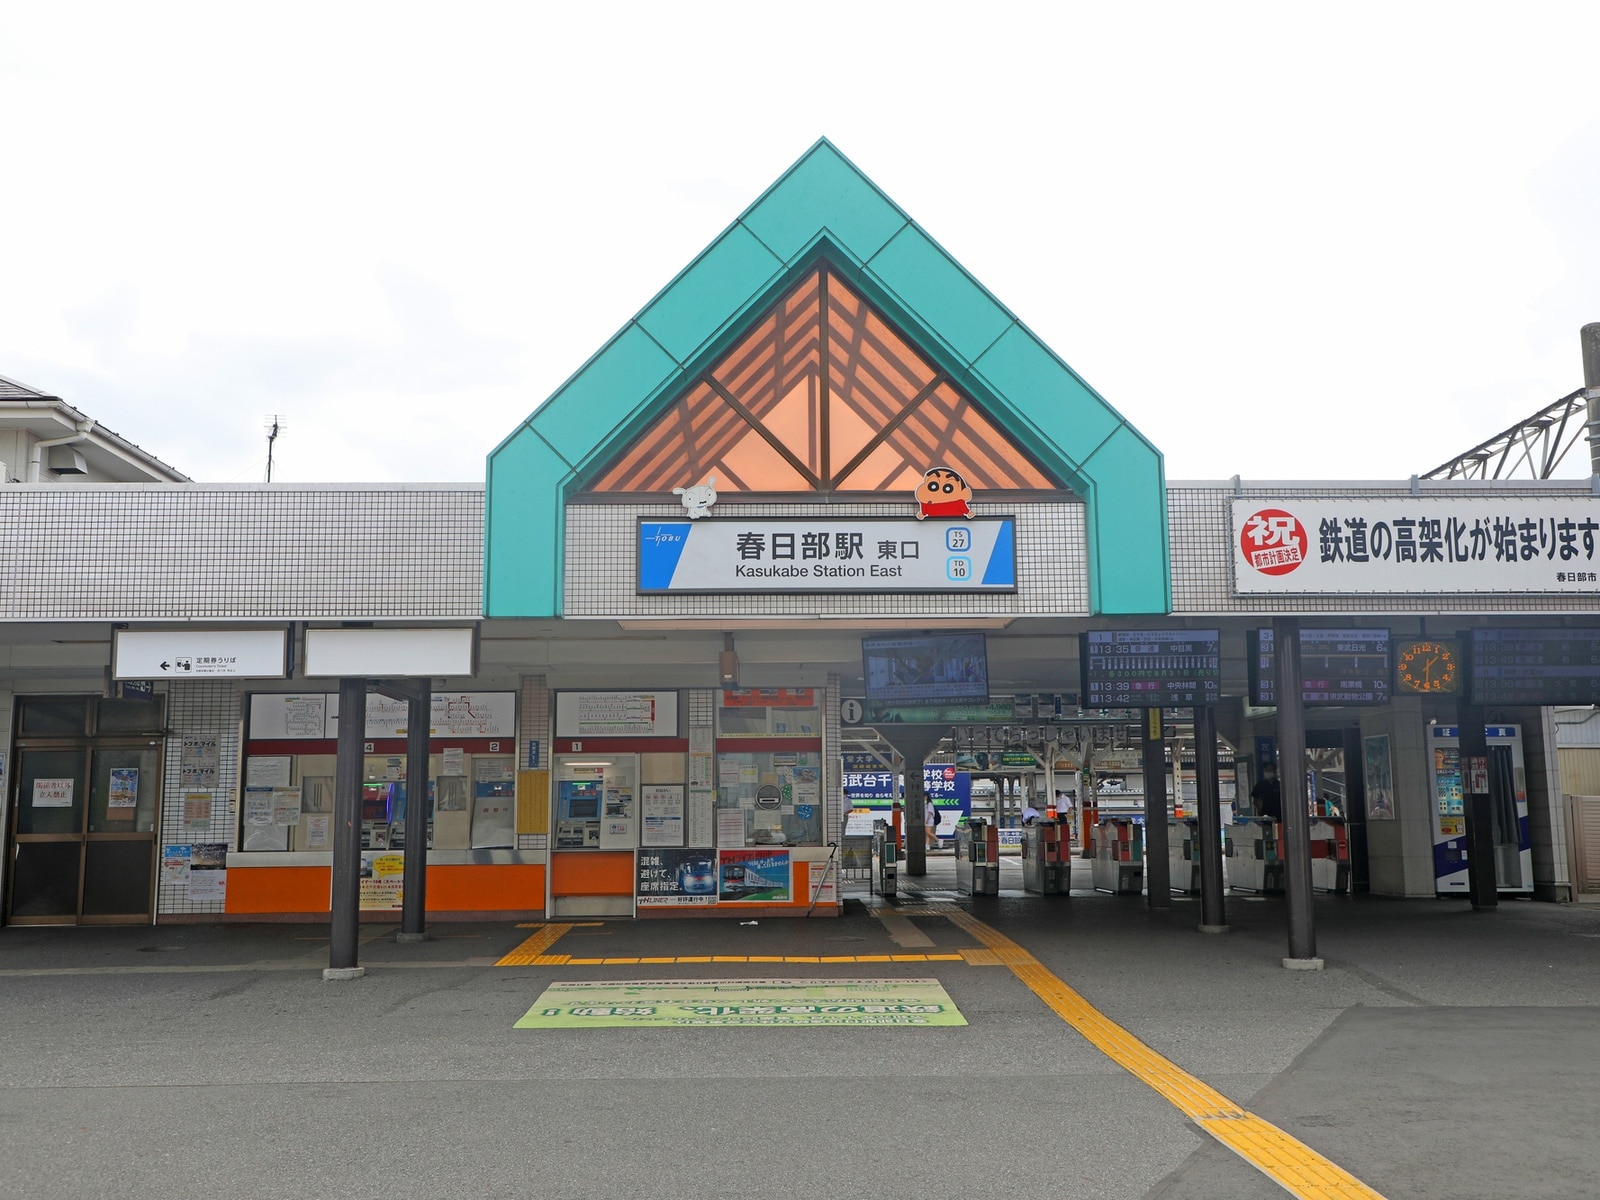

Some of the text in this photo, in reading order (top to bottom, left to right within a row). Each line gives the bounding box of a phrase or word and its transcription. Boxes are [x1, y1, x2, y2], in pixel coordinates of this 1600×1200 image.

[1247, 515, 1300, 546] 祝
[952, 538, 965, 548] 27
[1318, 516, 1600, 563] 鉄道の高架化が始まります
[736, 532, 920, 560] 春日部駅 東口
[1254, 547, 1300, 568] 都市計画決定
[736, 565, 903, 577] Kasukabe Station East
[953, 567, 966, 577] 10
[1556, 572, 1598, 583] 春日部市
[1099, 645, 1129, 654] 13:35
[1413, 646, 1421, 654] 11
[1422, 644, 1431, 652] 12
[1434, 646, 1439, 654] 1
[196, 656, 236, 664] 定期券うりば
[1404, 673, 1412, 681] 8
[1442, 673, 1449, 681] 4
[1099, 682, 1130, 691] 13:39
[1167, 682, 1197, 690] 中央林間
[1433, 679, 1440, 687] 5
[1099, 694, 1130, 703] 13:42
[365, 743, 373, 752] 4
[490, 742, 498, 751] 2
[574, 742, 580, 751] 1
[39, 791, 68, 799] 立入禁止
[640, 856, 664, 866] 混雑、
[640, 869, 671, 879] 避けて、
[640, 881, 684, 892] 座席指定。
